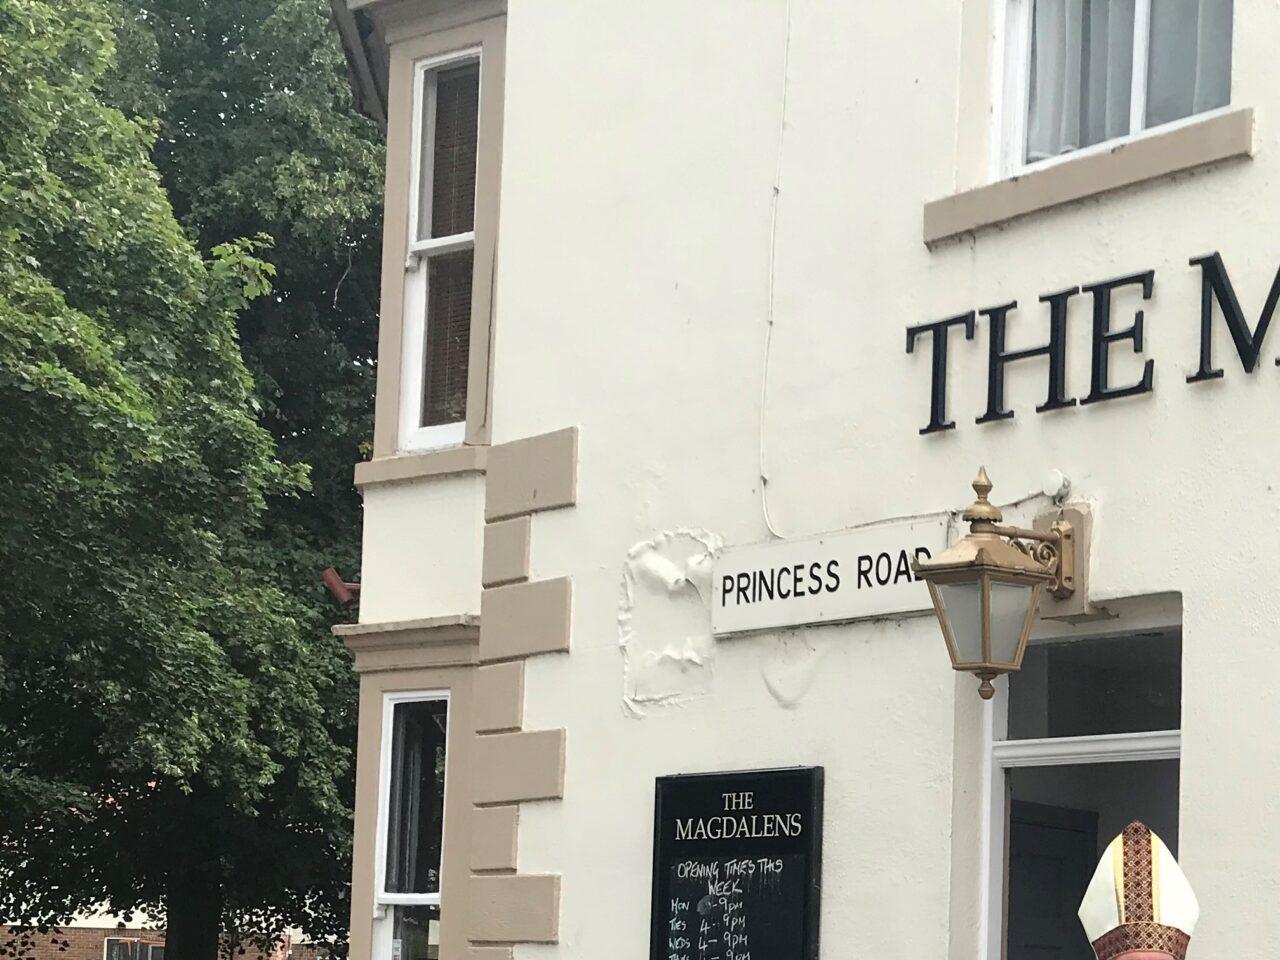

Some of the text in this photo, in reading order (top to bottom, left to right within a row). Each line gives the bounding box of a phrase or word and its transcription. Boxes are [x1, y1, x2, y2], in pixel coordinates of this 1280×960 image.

[906, 269, 1155, 435] THE
[722, 559, 841, 607] PRINCESS
[722, 792, 753, 810] THE
[675, 813, 801, 840] MAGDALENS
[677, 861, 719, 879] OPENING
[724, 859, 756, 879] TIMES
[708, 879, 743, 896] WEEK
